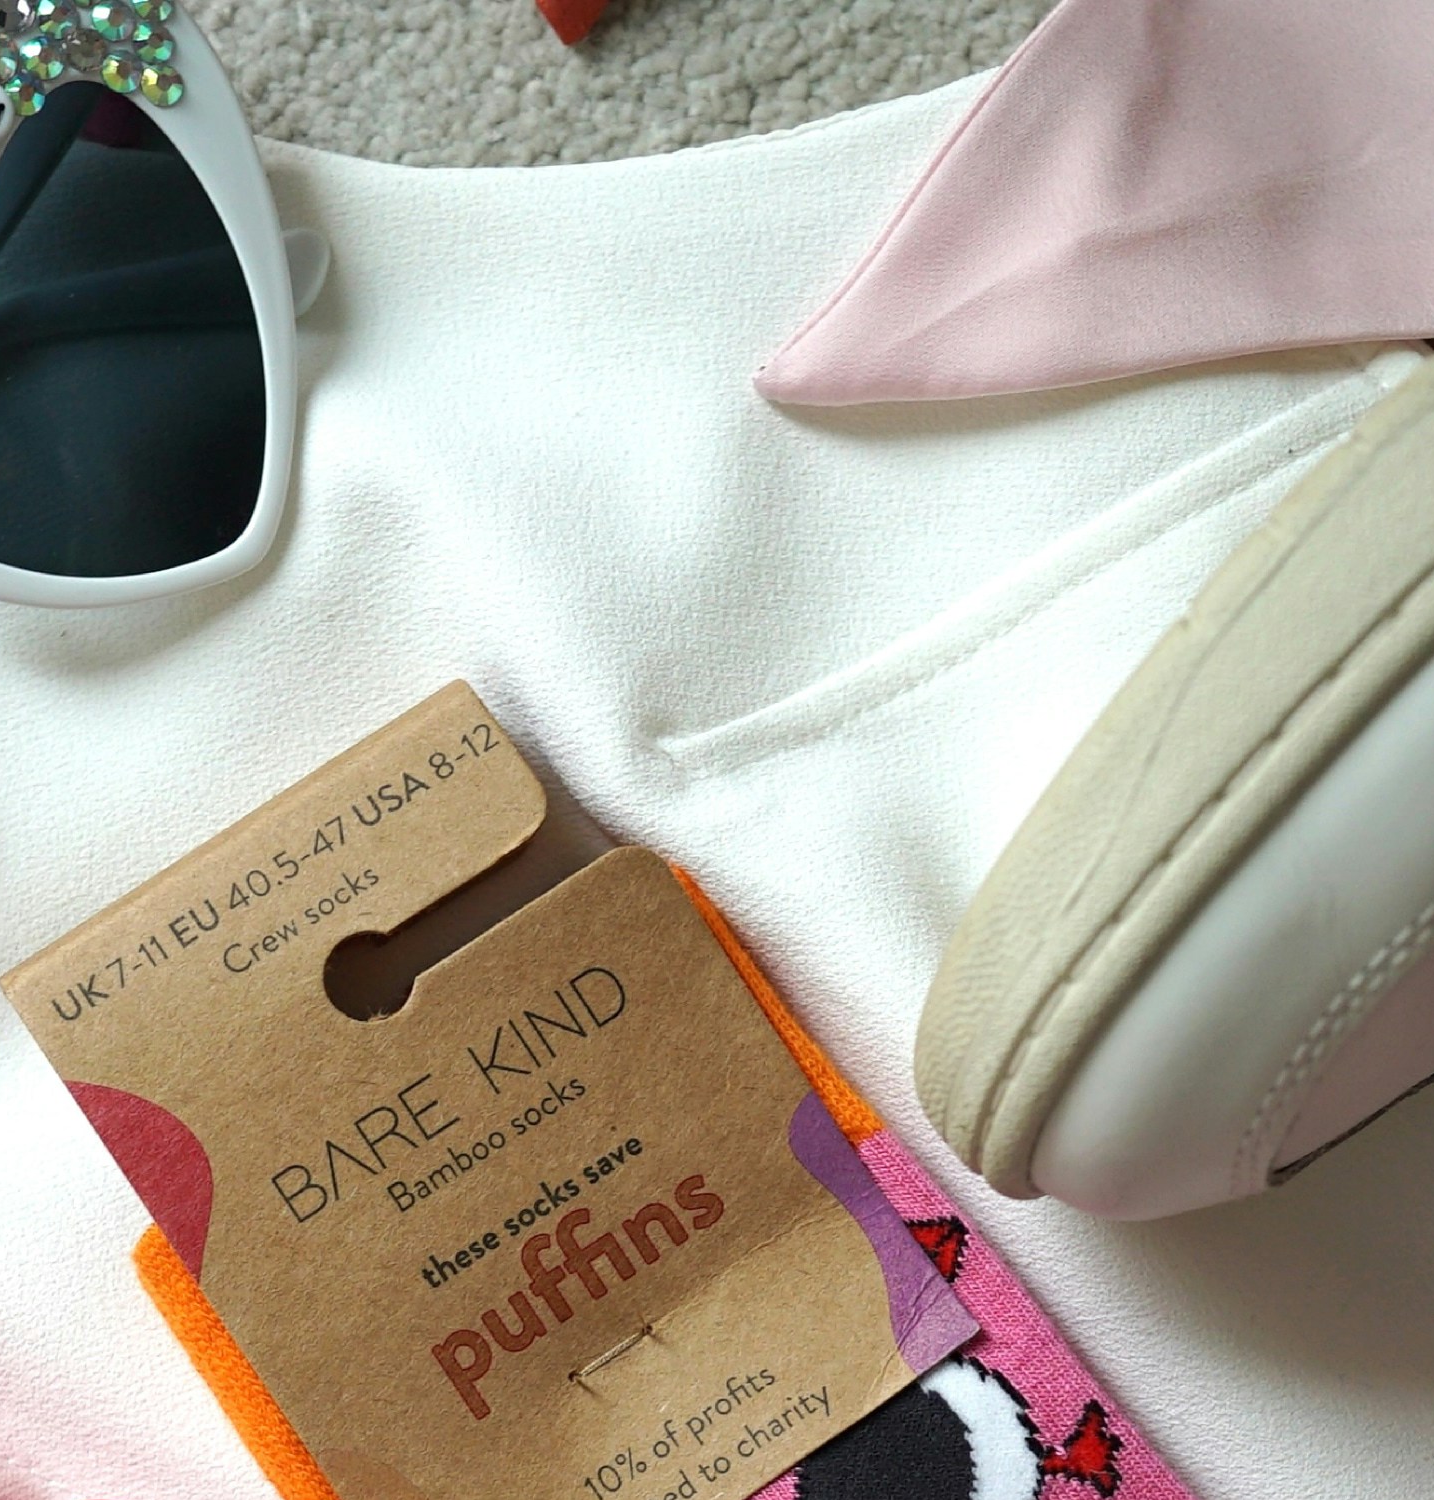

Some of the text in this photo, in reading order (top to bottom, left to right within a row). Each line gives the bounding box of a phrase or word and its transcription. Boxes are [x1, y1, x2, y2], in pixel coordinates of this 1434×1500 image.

[52, 723, 500, 1023] UK 7-11 EU 40.5-47 USA 8-12
[223, 865, 380, 975] Crew socks
[271, 967, 626, 1223] BARE KIND
[387, 1075, 586, 1213] Bamboo socks
[422, 1136, 643, 1289] these socks save
[431, 1174, 725, 1421] puffins
[652, 1418, 683, 1460] of
[684, 1366, 777, 1445] profits
[697, 1454, 733, 1485] to
[735, 1385, 833, 1460] charity
